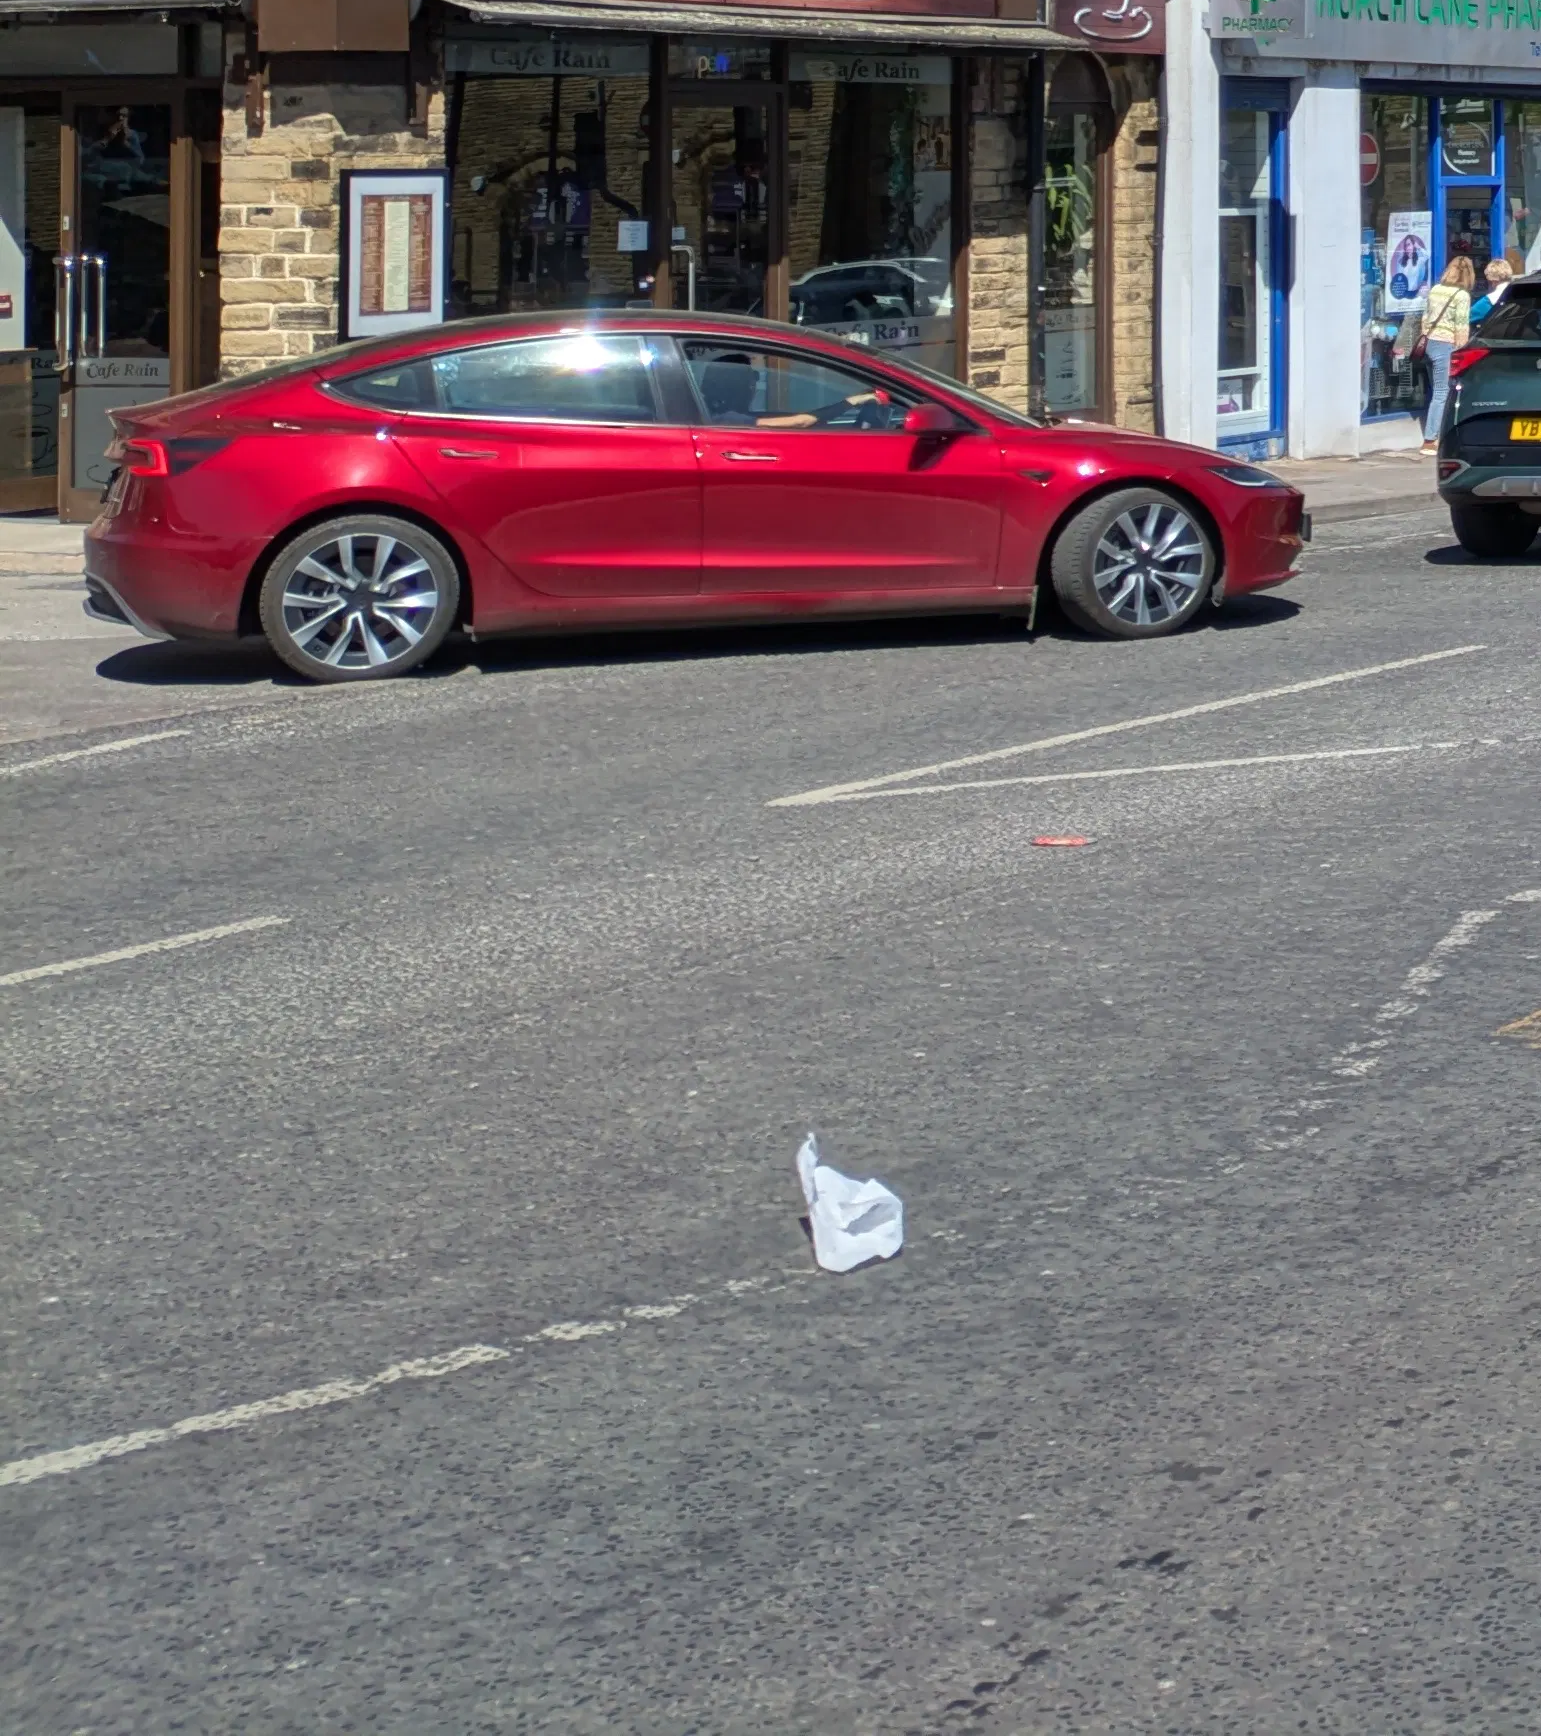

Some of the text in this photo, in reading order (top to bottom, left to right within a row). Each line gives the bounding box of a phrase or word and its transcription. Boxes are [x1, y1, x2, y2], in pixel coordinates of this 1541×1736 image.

[1222, 16, 1294, 33] PHARMACY
[874, 53, 921, 79] Rain
[86, 362, 159, 379] Cafe Rain
